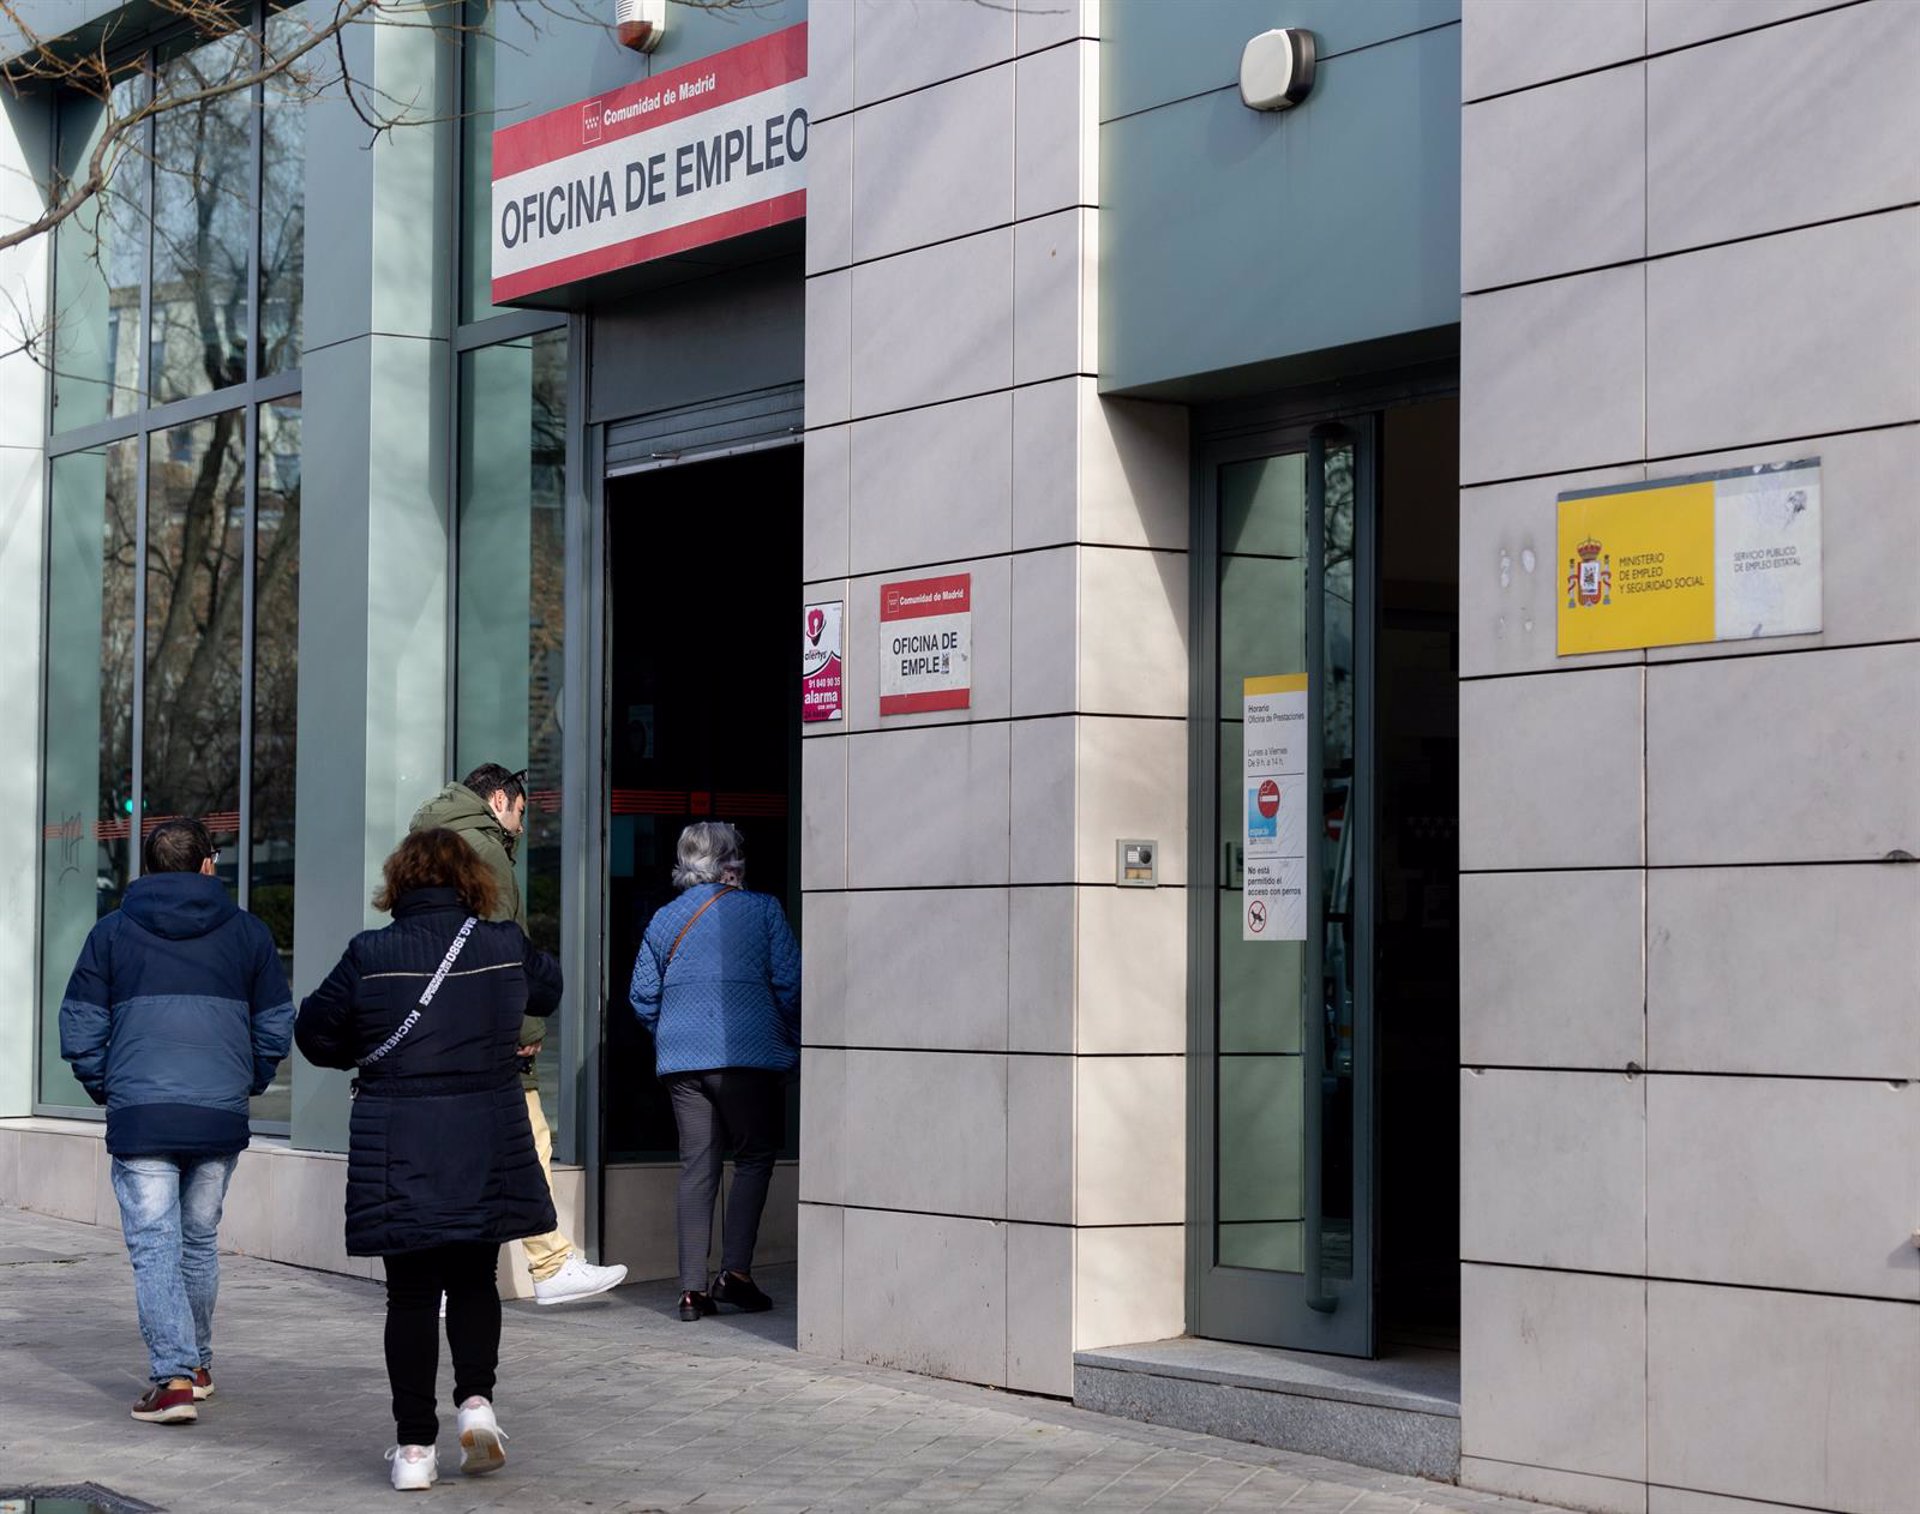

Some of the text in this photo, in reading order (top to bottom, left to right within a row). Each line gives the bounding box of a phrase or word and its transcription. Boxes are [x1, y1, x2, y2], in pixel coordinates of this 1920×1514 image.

[604, 73, 716, 126] Comunidad de Madrid
[501, 107, 808, 249] OFICINA DE EMPLEO
[1619, 552, 1665, 567] MINISTERIO
[1734, 557, 1802, 573] DE EMPLEO ESTATAL
[1619, 566, 1663, 581] DE EMPLEO
[1619, 575, 1704, 594] Y SEGURIDAD SOCIAL
[900, 588, 964, 606] Comunidad de Madrid
[893, 631, 958, 655] OFICINA DE
[902, 655, 949, 677] EMPLE
[808, 679, 815, 688] 91
[805, 690, 838, 704] alarma
[1248, 704, 1269, 713] Horario
[1248, 713, 1304, 724] Oficina de Prestaciones
[1248, 748, 1263, 757] Lunes
[1269, 747, 1287, 755] Viernes
[1248, 865, 1270, 875] No está
[1248, 876, 1275, 887] permitido
[1248, 887, 1302, 897] acceso con perros
